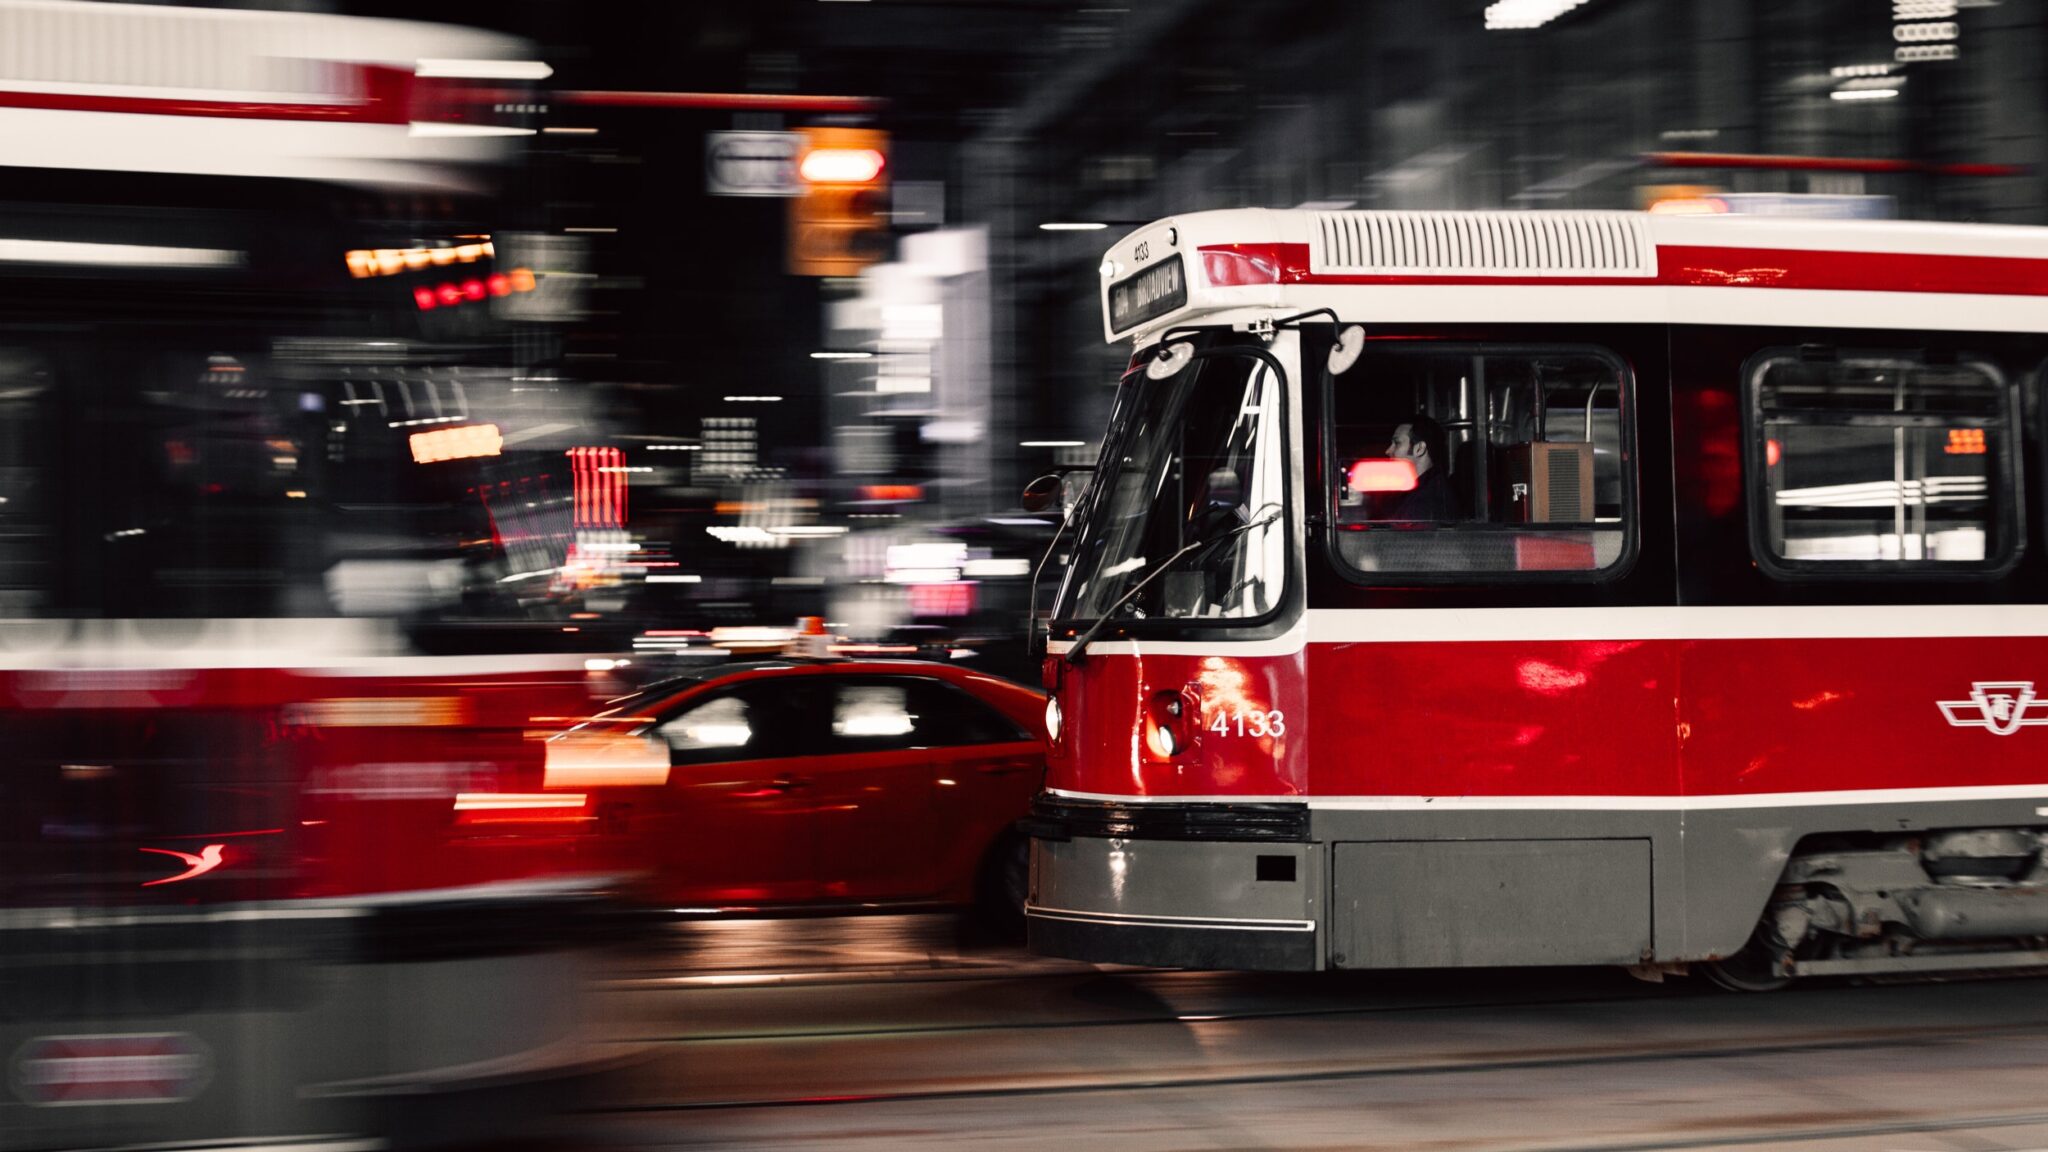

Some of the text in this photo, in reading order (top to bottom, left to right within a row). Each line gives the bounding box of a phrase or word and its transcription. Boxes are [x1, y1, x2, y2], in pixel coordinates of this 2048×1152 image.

[1134, 241, 1149, 262] 4133
[1137, 260, 1179, 308] BROADVIEW
[1210, 709, 1286, 737] 4133
